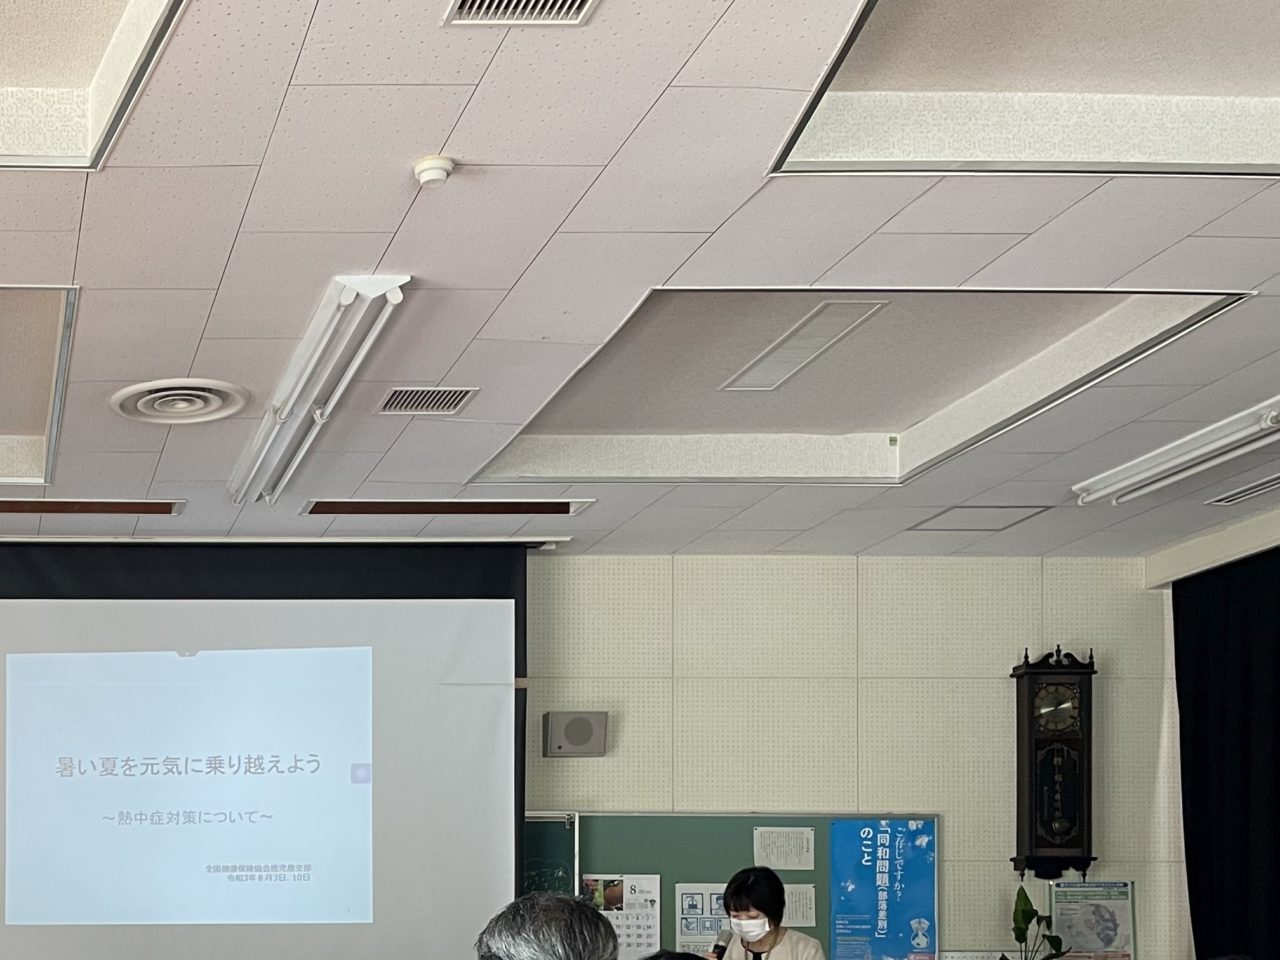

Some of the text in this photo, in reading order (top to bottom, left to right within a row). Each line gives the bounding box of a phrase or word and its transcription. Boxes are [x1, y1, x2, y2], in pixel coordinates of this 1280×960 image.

[56, 754, 321, 778] 暑い夏を元気に乗り越えよう
[860, 827, 873, 866] のこと
[630, 885, 637, 894] 8
